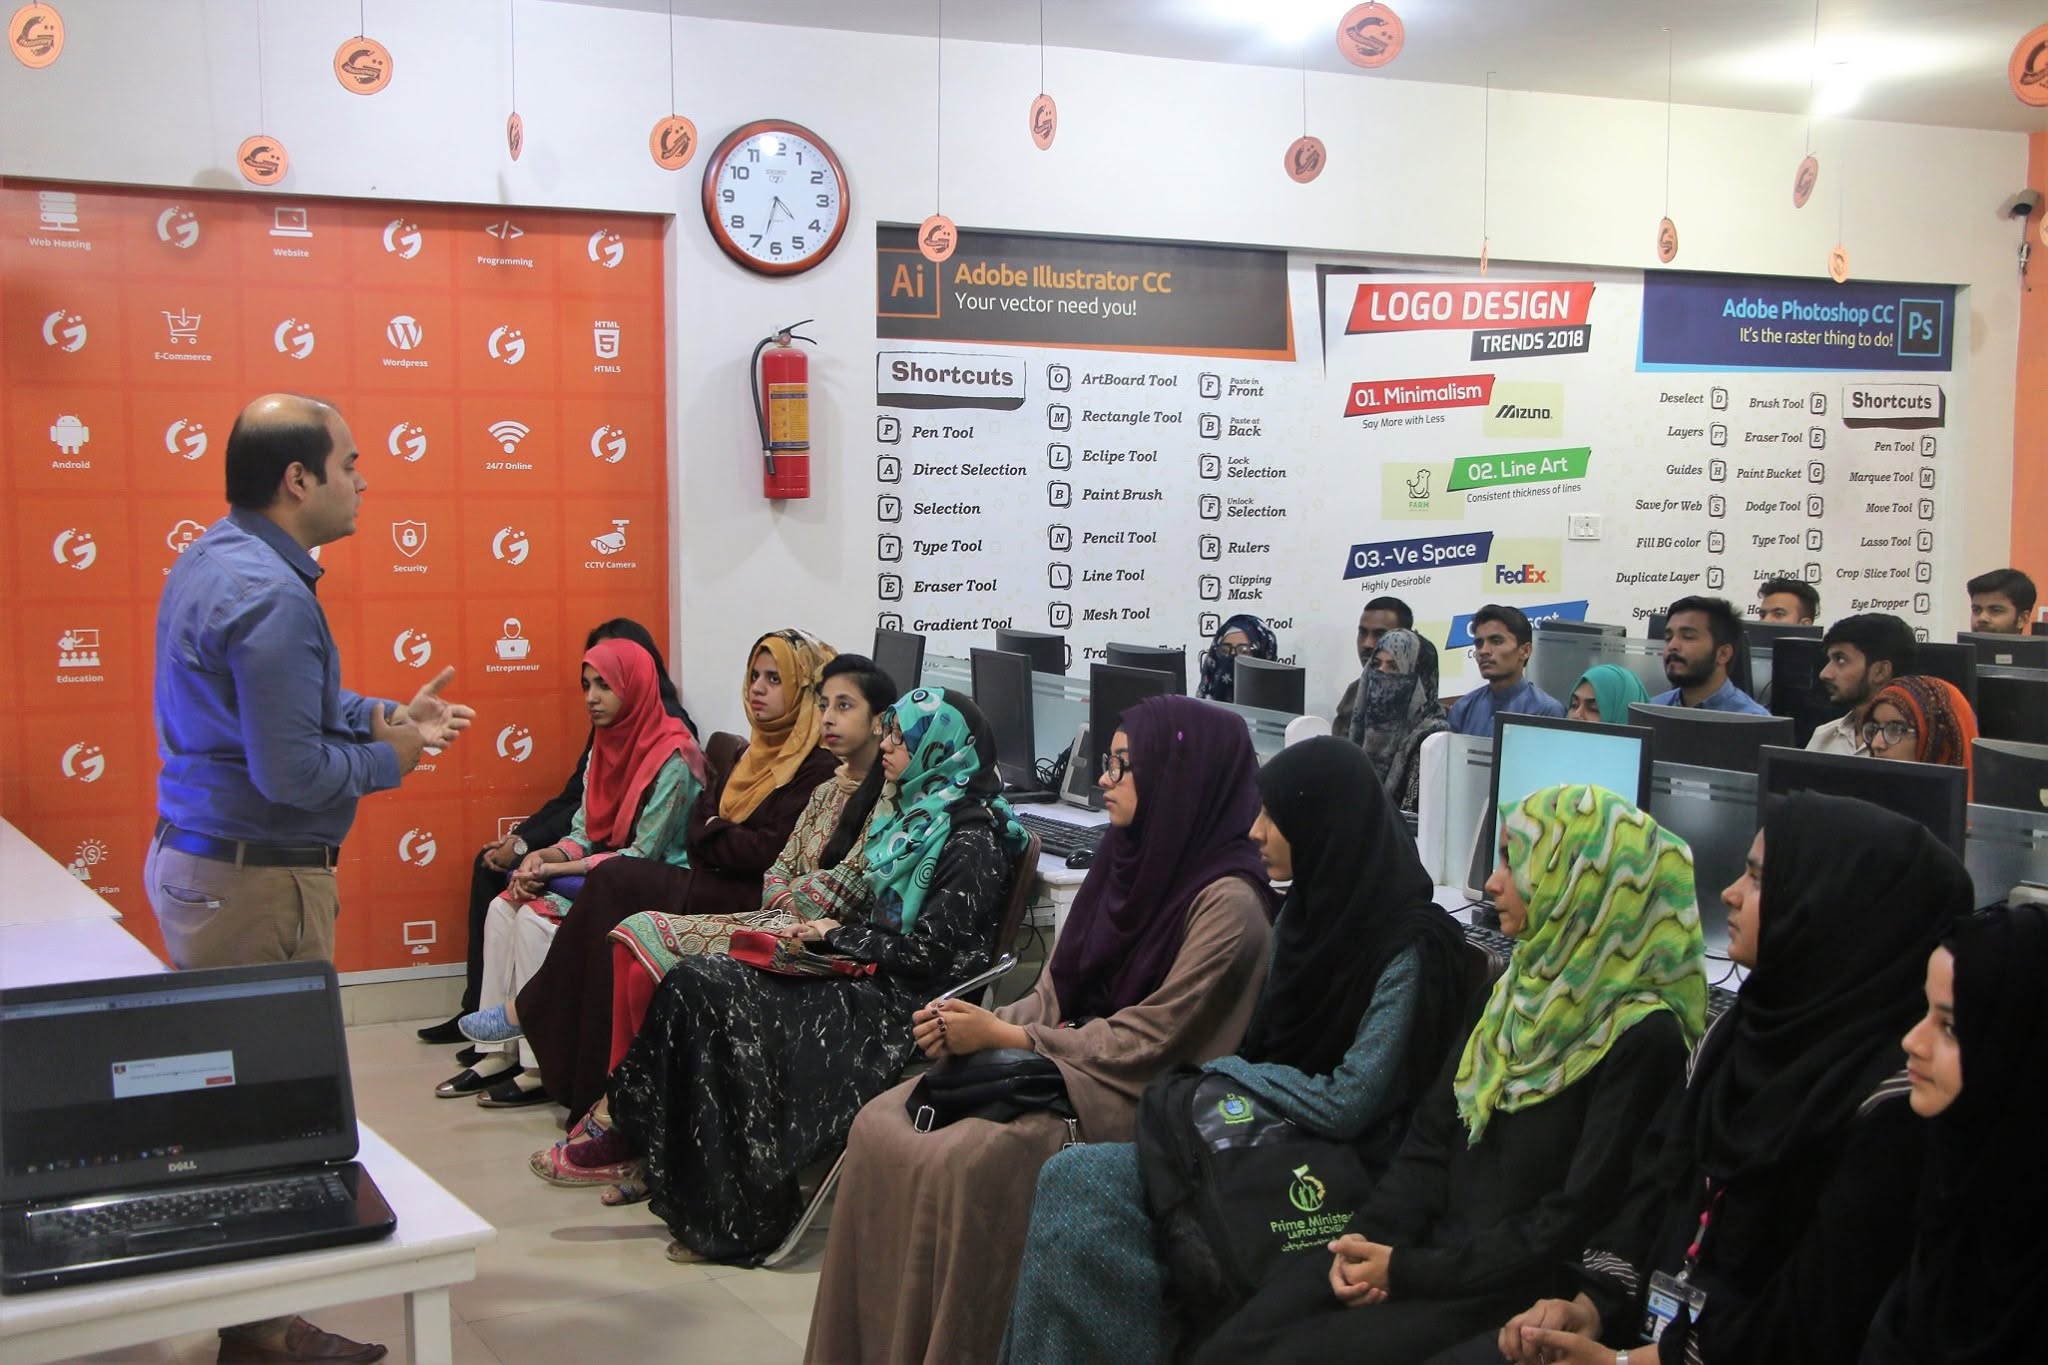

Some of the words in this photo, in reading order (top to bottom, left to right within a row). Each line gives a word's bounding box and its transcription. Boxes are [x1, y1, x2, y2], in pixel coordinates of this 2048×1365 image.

[747, 148, 760, 163] 11
[730, 166, 750, 180] 10
[810, 171, 824, 184] 2
[722, 189, 735, 203] 9
[816, 194, 829, 208] 3
[731, 215, 744, 229] 8
[808, 219, 821, 232] 4
[29, 238, 52, 247] Web
[53, 239, 92, 251] Hosting
[749, 234, 763, 248] 7
[792, 236, 805, 250] 5
[273, 248, 310, 258] Website
[770, 242, 782, 255] 6
[477, 256, 534, 268] Programming
[890, 264, 924, 298] Ai
[954, 262, 1028, 288] Adobe
[1032, 265, 1139, 292] Illustrator
[1142, 272, 1172, 293] CC
[955, 293, 996, 311] Your
[1000, 295, 1055, 313] vector
[1057, 298, 1099, 314] need
[1102, 300, 1137, 319] you!
[1370, 290, 1453, 321] LOGO
[1461, 290, 1570, 320] DESIGN
[1722, 298, 1779, 320] Adobe
[1781, 300, 1869, 326] Photoshop
[1871, 305, 1895, 324] CC
[594, 320, 619, 329] HTML
[1907, 312, 1933, 341] Ps
[1480, 333, 1544, 353] TRENDS
[1547, 330, 1583, 349] 2018
[1740, 328, 1759, 343] It's
[1761, 328, 1783, 343] the
[1785, 331, 1823, 346] raster
[1824, 330, 1856, 349] thing
[1858, 333, 1872, 347] to
[1874, 333, 1894, 347] do!
[154, 352, 212, 362] E-Commerce
[382, 359, 429, 369] Wordpress
[593, 365, 622, 373] HTML5
[891, 360, 1014, 386] Shortcuts
[1081, 373, 1145, 386] ArtBoard
[1148, 375, 1178, 387] Tool
[1229, 377, 1250, 385] Paste
[1228, 384, 1265, 397] Front
[1355, 389, 1381, 408] 01.
[1384, 383, 1482, 406] Minimalism
[1660, 392, 1704, 404] Deselect
[1749, 398, 1780, 408] Brush
[1782, 399, 1804, 409] Tool
[1852, 391, 1932, 409] Shortcuts
[1081, 410, 1151, 426] Rectangle
[1153, 411, 1183, 423] Tool
[1362, 418, 1379, 431] Say
[1380, 416, 1403, 428] More
[1404, 415, 1424, 426] with
[1425, 413, 1445, 425] Less
[912, 427, 938, 439] Pen
[942, 427, 974, 439] Tool
[1228, 425, 1261, 436] Back
[1667, 426, 1704, 439] Layers
[1744, 432, 1779, 443] Eraser
[1781, 432, 1803, 443] Tool
[1874, 442, 1892, 451] Pen
[1894, 441, 1915, 451] Tool
[1082, 449, 1125, 464] Eclipe
[1128, 450, 1158, 462] Tool
[1227, 456, 1250, 465] Lock
[52, 460, 91, 470] Android
[485, 462, 504, 471] 24/7
[505, 462, 533, 471] Online
[913, 463, 958, 476] Direct
[960, 464, 1027, 476] Selection
[1468, 463, 1498, 481] 02.
[1500, 460, 1536, 479] Line
[1539, 456, 1569, 475] Art
[1666, 464, 1703, 475] Guides
[1227, 466, 1287, 478] Selection
[1736, 468, 1765, 479] Paint
[1766, 468, 1802, 479] Bucket
[1848, 472, 1891, 484] Marquee
[1893, 472, 1914, 482] Tool
[1082, 488, 1120, 501] Paint
[1121, 488, 1163, 501] Brush
[1467, 488, 1510, 503] Consistent
[1511, 486, 1550, 498] thickness
[1551, 484, 1561, 494] of
[1562, 483, 1581, 493] lines
[1227, 497, 1254, 505] Unlock
[1408, 501, 1430, 509] FARM
[1635, 500, 1661, 511] Save
[1661, 499, 1678, 513] for
[1680, 500, 1702, 511] Web
[1745, 501, 1777, 514] Dodge
[1779, 501, 1801, 511] Tool
[913, 502, 981, 515] Selection
[1227, 505, 1287, 518] Selection
[1865, 503, 1890, 513] Move
[1891, 503, 1913, 513] Tool
[1082, 532, 1125, 544] Pencil
[1127, 532, 1157, 543] Tool
[1636, 538, 1656, 548] Fill
[1656, 538, 1672, 548] BG
[1674, 537, 1701, 548] color
[1752, 535, 1777, 547] Type
[1779, 535, 1800, 545] Tool
[1861, 537, 1889, 547] Lasso
[1890, 536, 1911, 546] Tool
[913, 540, 948, 555] Type
[951, 540, 983, 552] Tool
[1227, 542, 1270, 553] Rulers
[1422, 544, 1477, 566] Space
[393, 564, 429, 574] Security
[584, 561, 605, 569] CCTV
[606, 561, 637, 569] Camera
[1082, 569, 1113, 581] Line
[1116, 569, 1145, 581] Tool
[1228, 574, 1272, 586] Clipping
[1495, 564, 1547, 584] FedEx
[1616, 573, 1668, 585] Duplicate
[1669, 573, 1700, 585] Layer
[1753, 570, 1776, 580] Line
[1777, 569, 1800, 580] Tool
[1836, 568, 1860, 580] Crop
[1863, 568, 1888, 579] Slice
[1889, 568, 1910, 578] Tool
[913, 581, 963, 593] Eraser
[966, 580, 997, 592] Tool
[1361, 578, 1388, 593] Highly
[1390, 574, 1431, 588] Desirable
[1227, 589, 1263, 600] Mask
[1851, 599, 1868, 611] Eye
[1870, 599, 1909, 610] Dropper
[1083, 608, 1118, 621] Mesh
[1121, 607, 1151, 620] Tool
[913, 619, 978, 632] Gradient
[981, 617, 1013, 630] Tool
[1266, 617, 1293, 629] Tool
[486, 663, 540, 674] Entrepreneur
[56, 674, 104, 684] Education
[99, 886, 120, 894] Plan
[168, 1161, 198, 1173] DELL
[1270, 1219, 1306, 1233] Prime
[1287, 1227, 1318, 1240] LAPTOP
